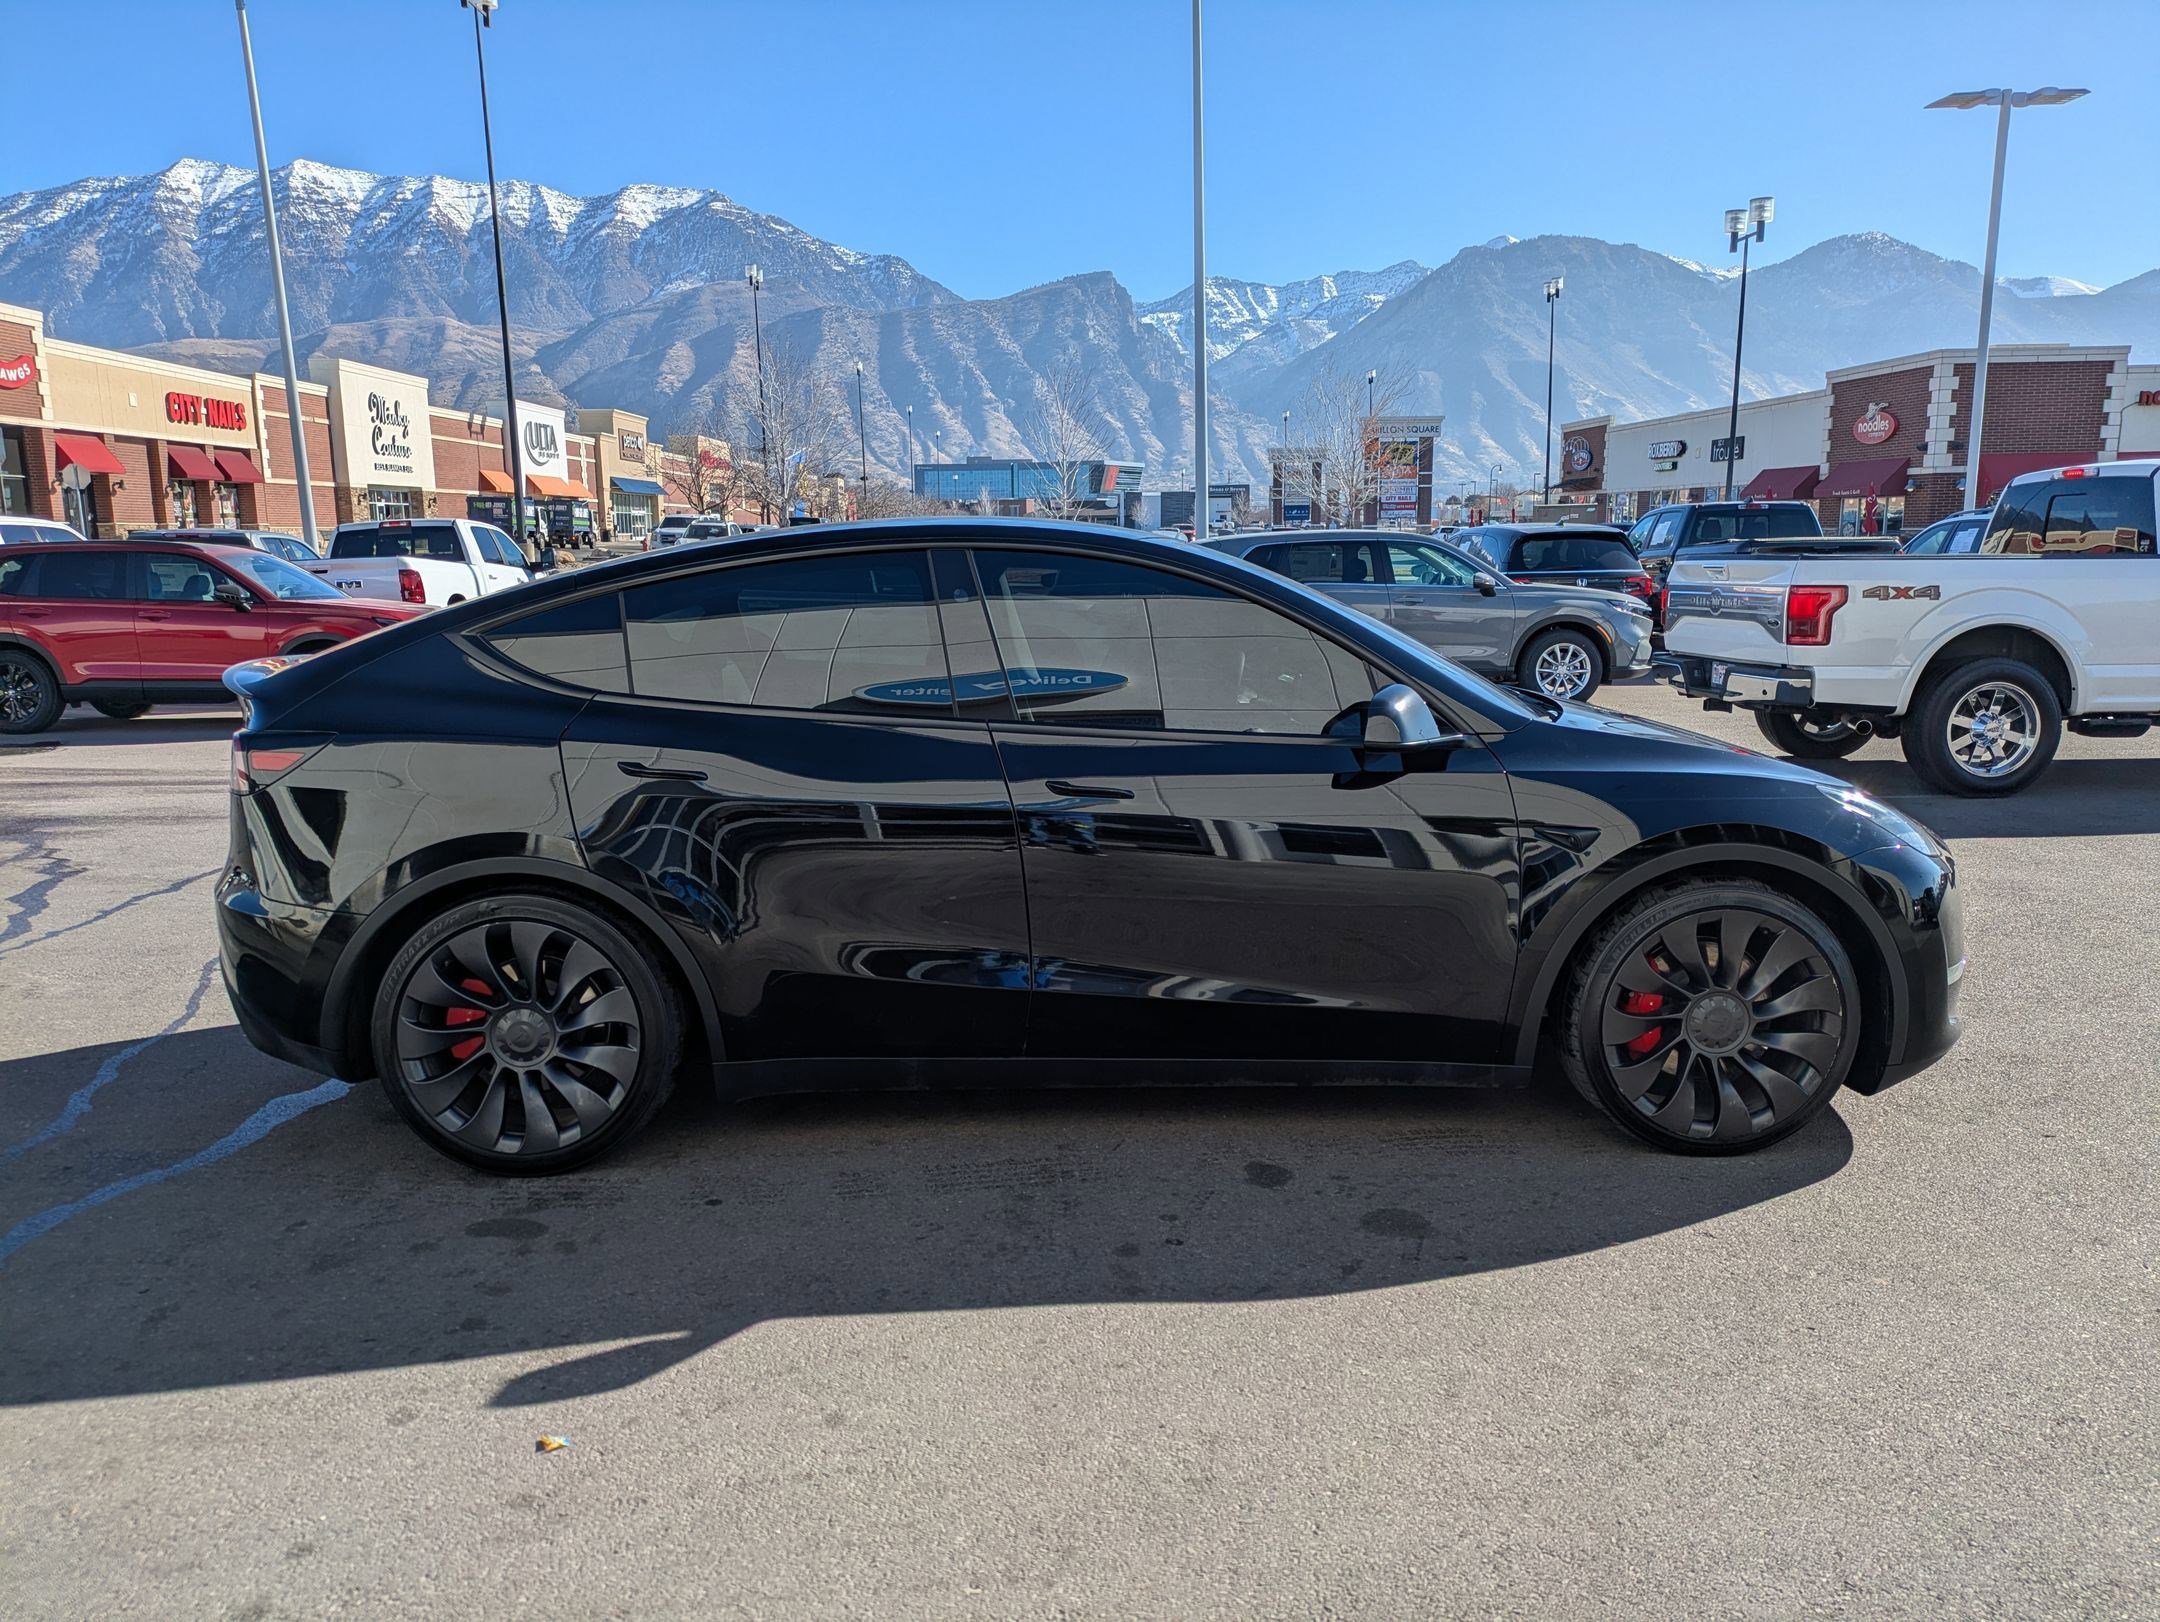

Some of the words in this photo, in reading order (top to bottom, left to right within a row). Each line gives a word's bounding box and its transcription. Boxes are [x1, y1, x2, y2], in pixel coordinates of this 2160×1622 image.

[165, 392, 202, 424] CITY
[204, 398, 247, 431] NAILS
[368, 392, 410, 439] Minky
[1857, 414, 1889, 433] noodles
[527, 421, 559, 453] ULTA
[1407, 425, 1440, 434] SQUARE
[1712, 445, 1740, 461] troue
